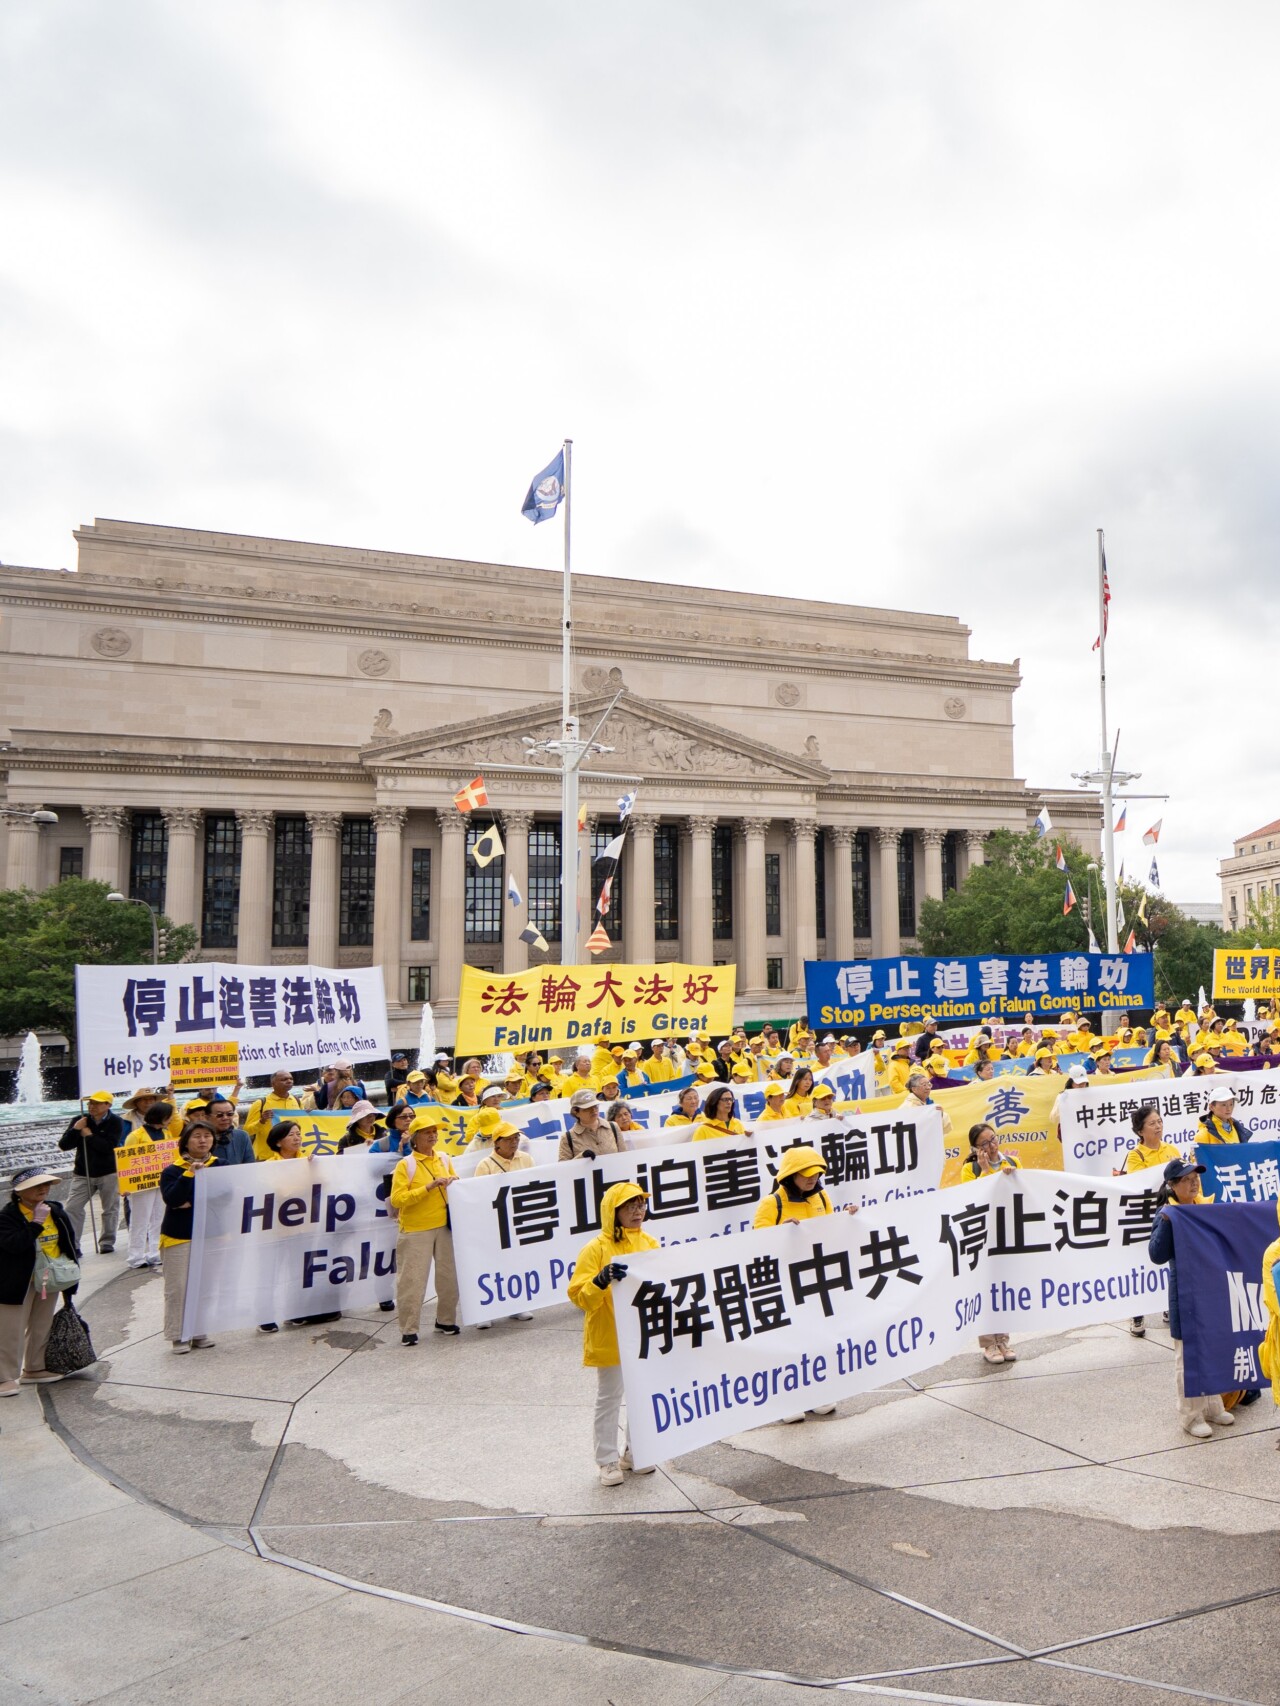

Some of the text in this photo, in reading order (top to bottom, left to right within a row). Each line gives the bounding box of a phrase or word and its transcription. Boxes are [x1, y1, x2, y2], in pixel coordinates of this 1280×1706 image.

[484, 781, 537, 792] RCHIVES
[638, 787, 670, 797] TATES
[480, 971, 719, 1017] 法輪大法好
[835, 956, 1131, 1005] 停止迫害法輪功
[1222, 985, 1236, 995] The
[1237, 984, 1261, 995] World
[122, 975, 362, 1038] 停止迫害法輪功
[820, 988, 1144, 1027] Stop Persecution of Falun Gong in China
[268, 1044, 284, 1060] of
[283, 1040, 314, 1059] Falun
[317, 1038, 340, 1057] Gong
[340, 1038, 350, 1052] in
[349, 1035, 378, 1052] China
[494, 1012, 708, 1047] Falun Dafa is Great
[103, 1053, 144, 1078] Help
[172, 1069, 184, 1077] END
[185, 1068, 196, 1076] THE
[985, 1086, 1030, 1129] 善
[1074, 1138, 1108, 1159] CCP
[118, 1167, 143, 1178] FORCED
[144, 1163, 160, 1173] INTO
[128, 1176, 142, 1184] FOR
[137, 1181, 156, 1190] FALUN
[240, 1183, 356, 1234] Help
[302, 1240, 397, 1289] Falu
[630, 1187, 1158, 1360] 解體中共 停止迫害
[477, 1265, 542, 1307] Stop
[651, 1265, 1171, 1434] Disintegrate the CCP, Stop the Persecution
